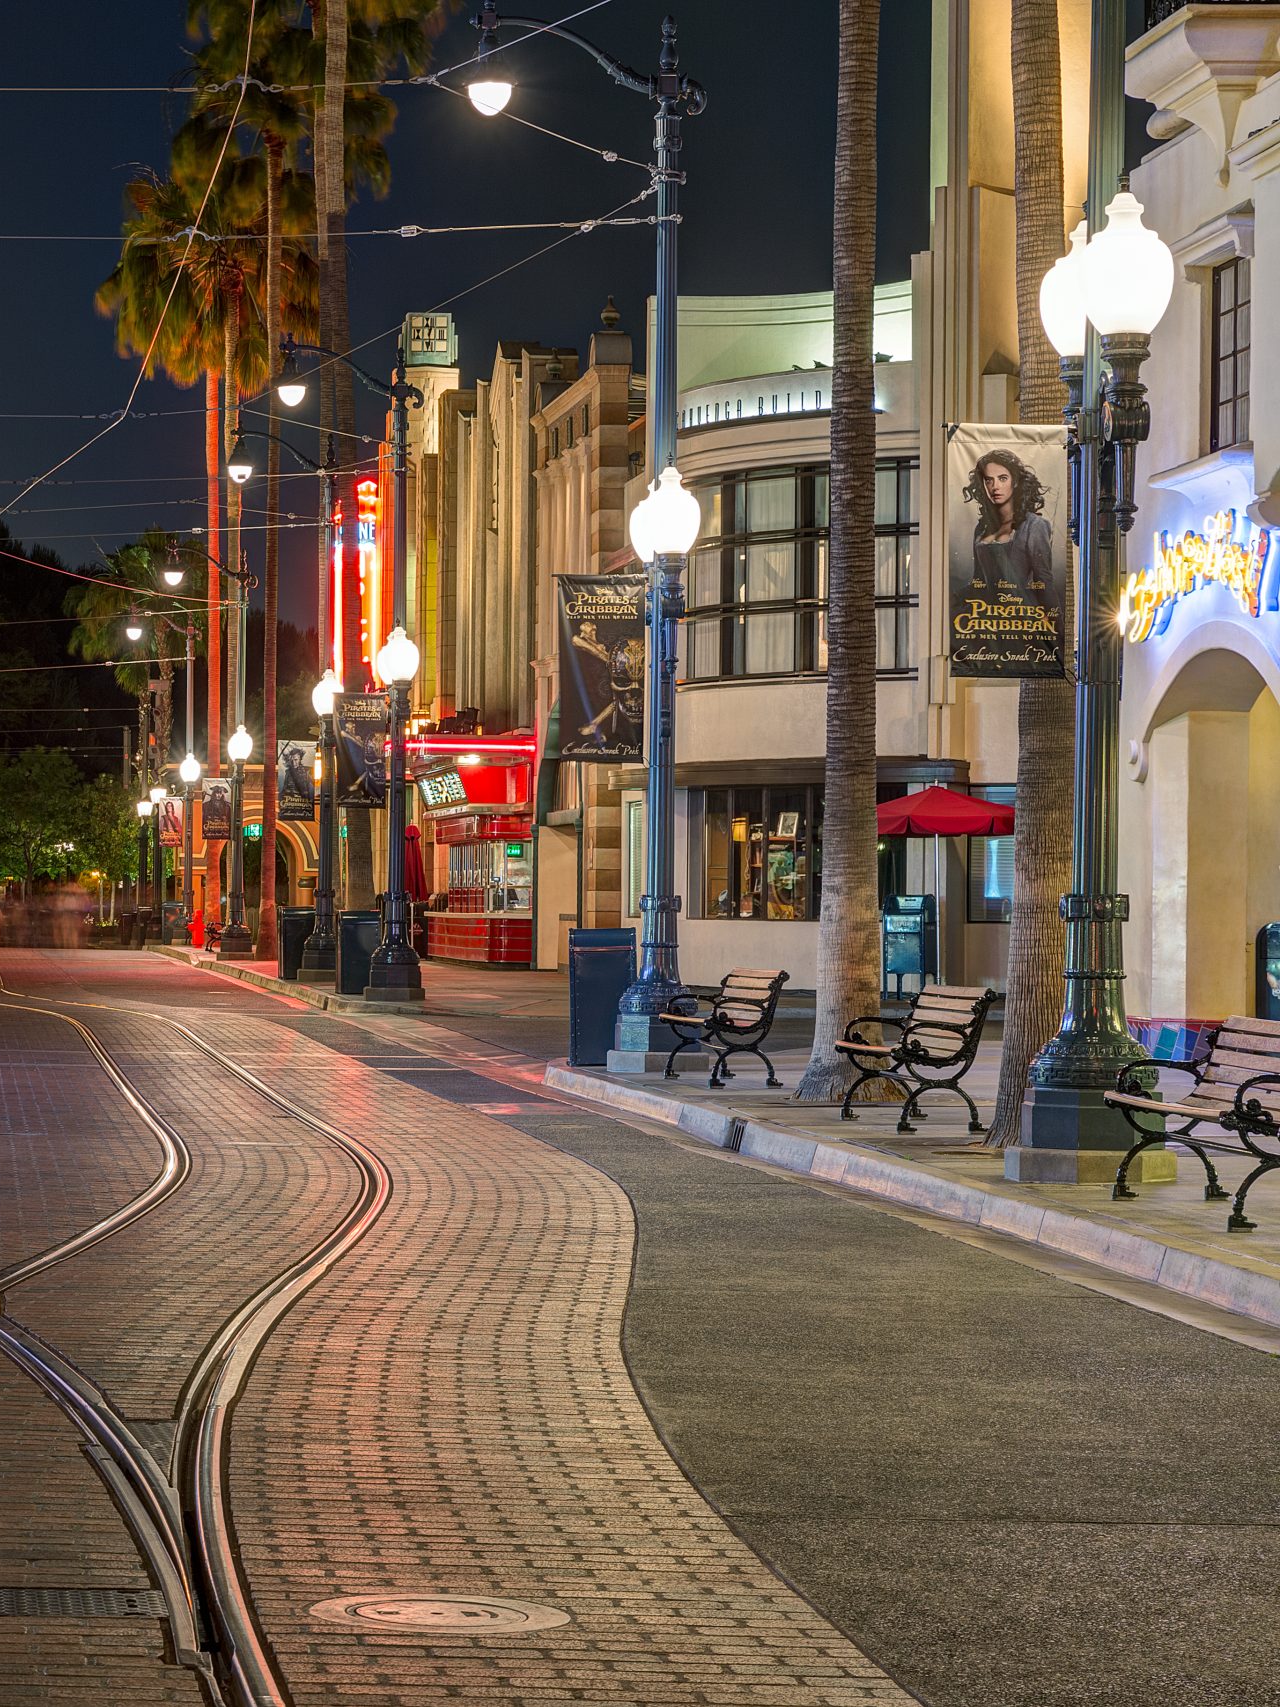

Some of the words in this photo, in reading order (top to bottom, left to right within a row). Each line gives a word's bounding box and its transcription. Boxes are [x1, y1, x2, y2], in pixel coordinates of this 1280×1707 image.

[675, 399, 742, 430] AHUENGA
[573, 591, 630, 605] PIRATES
[997, 592, 1024, 604] Disney
[565, 601, 639, 615] CARIBBEAN
[965, 599, 1045, 618] PIRATES
[953, 613, 1059, 634] CARIBBEAN
[952, 645, 999, 662] Exclusive
[1000, 645, 1033, 662] Sneak
[1033, 646, 1059, 663] Peek
[342, 703, 377, 712] PIRATES
[621, 743, 642, 756] Peek
